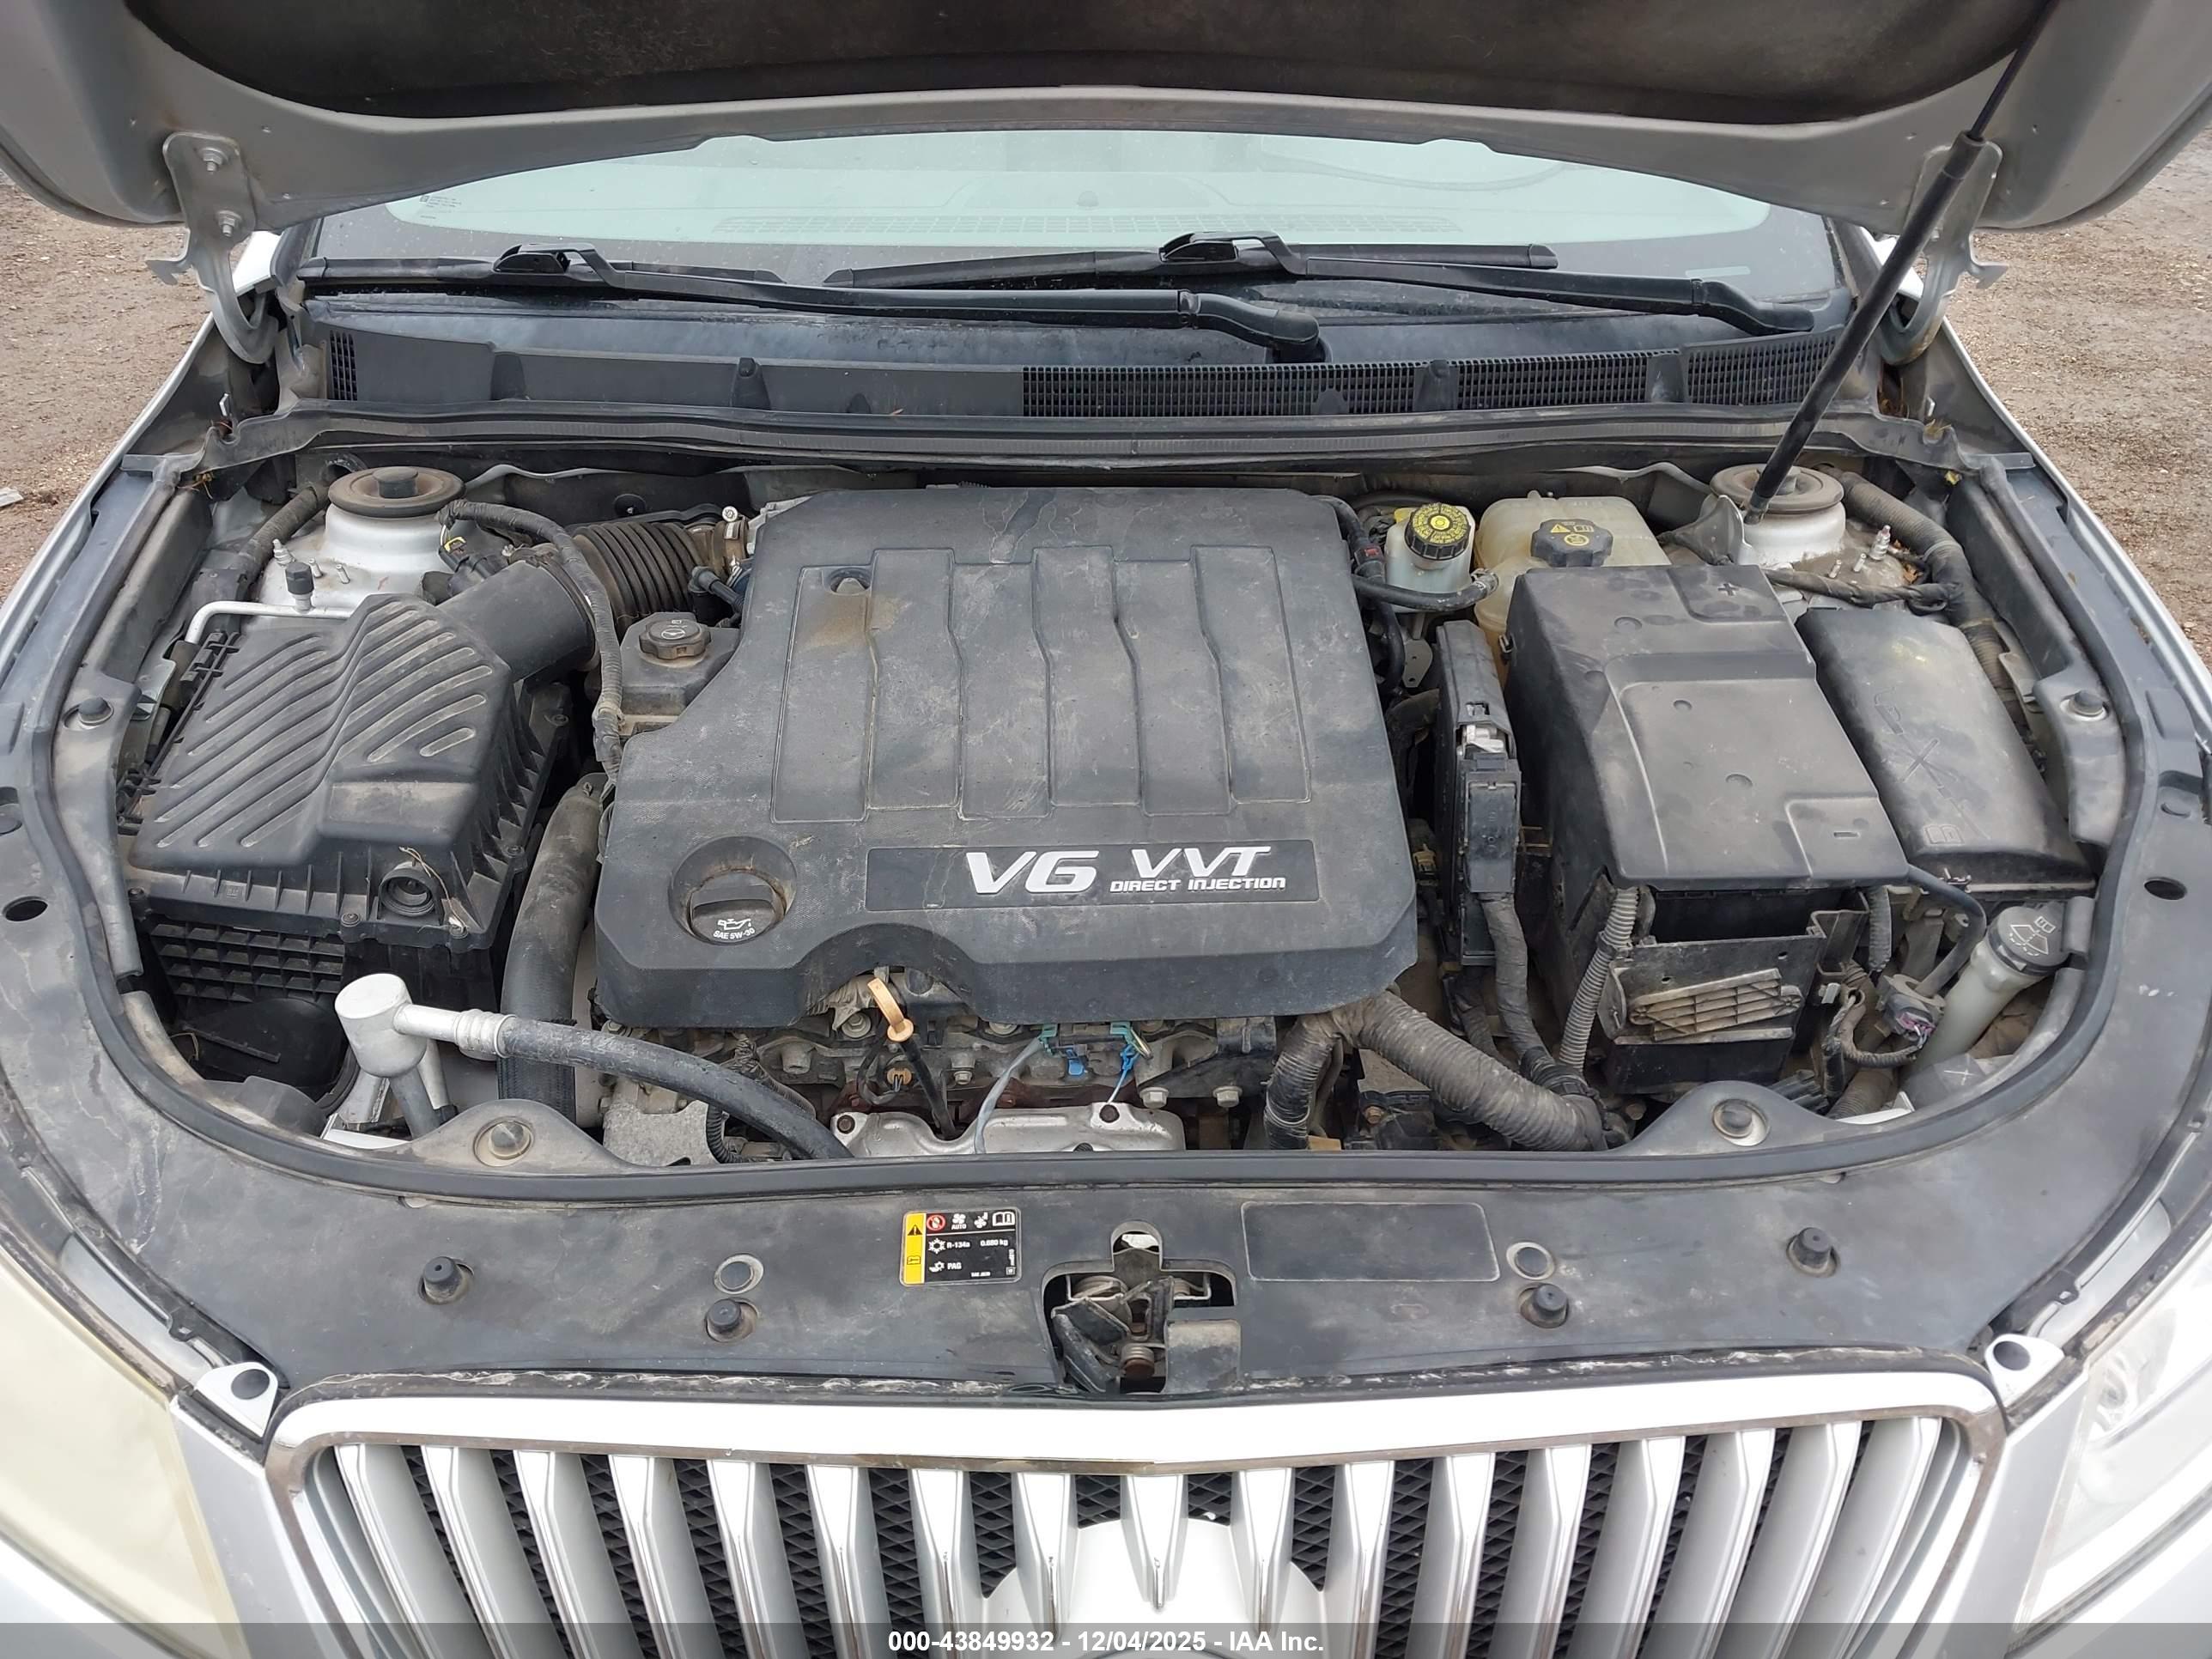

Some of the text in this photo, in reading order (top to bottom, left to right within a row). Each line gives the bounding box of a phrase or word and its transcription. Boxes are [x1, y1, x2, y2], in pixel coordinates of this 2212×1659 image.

[966, 846, 1272, 895] V6 VVT
[1109, 876, 1286, 894] DIRECT INJECTION
[713, 927, 756, 940] SAE 5W-30
[946, 1240, 971, 1249] R-134a
[946, 1261, 963, 1270] PAG
